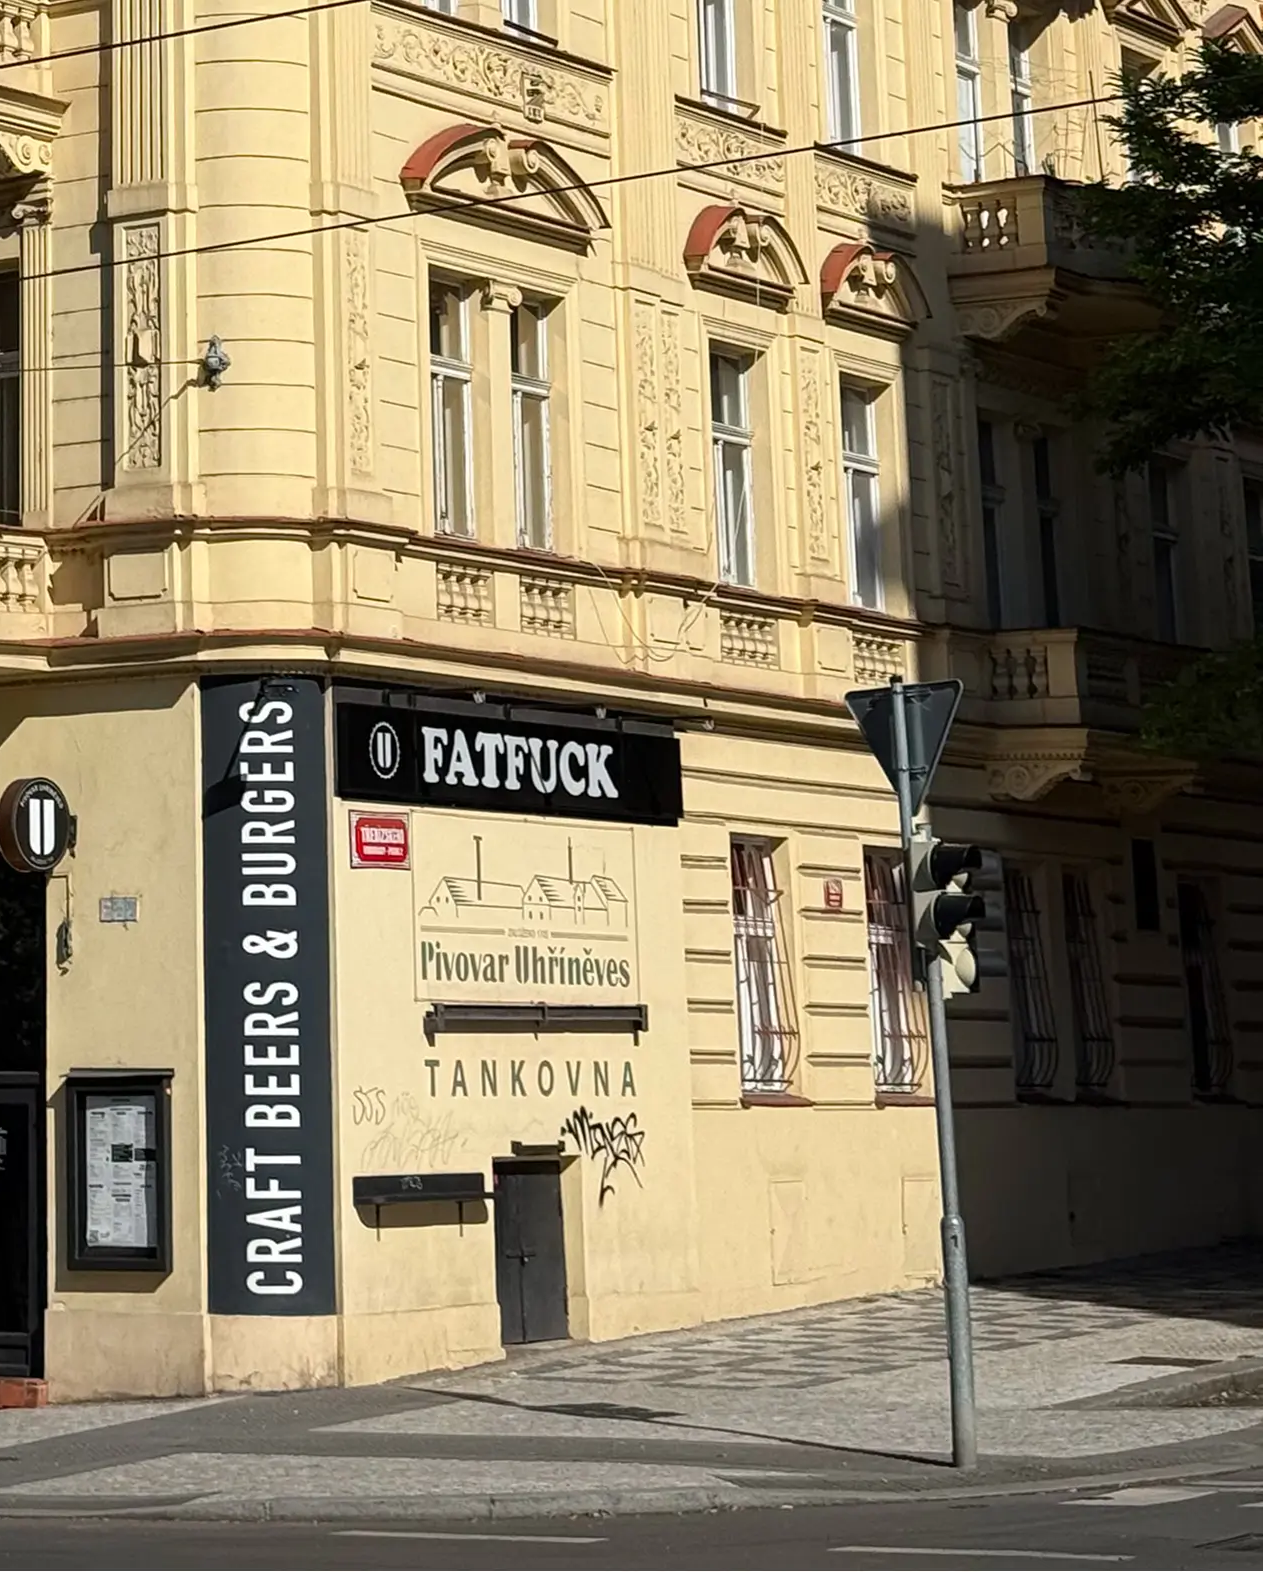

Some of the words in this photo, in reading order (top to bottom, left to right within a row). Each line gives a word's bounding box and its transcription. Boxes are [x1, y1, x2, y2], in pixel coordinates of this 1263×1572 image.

[421, 726, 619, 798] FATFUCK
[239, 701, 297, 906] BURGERS
[242, 930, 299, 959] &
[421, 941, 509, 983] Pivovar
[515, 945, 630, 988] Uhříněves
[243, 982, 301, 1128] BEERS
[424, 1059, 637, 1097] TANKOVNA
[246, 1147, 303, 1295] CRAFT
